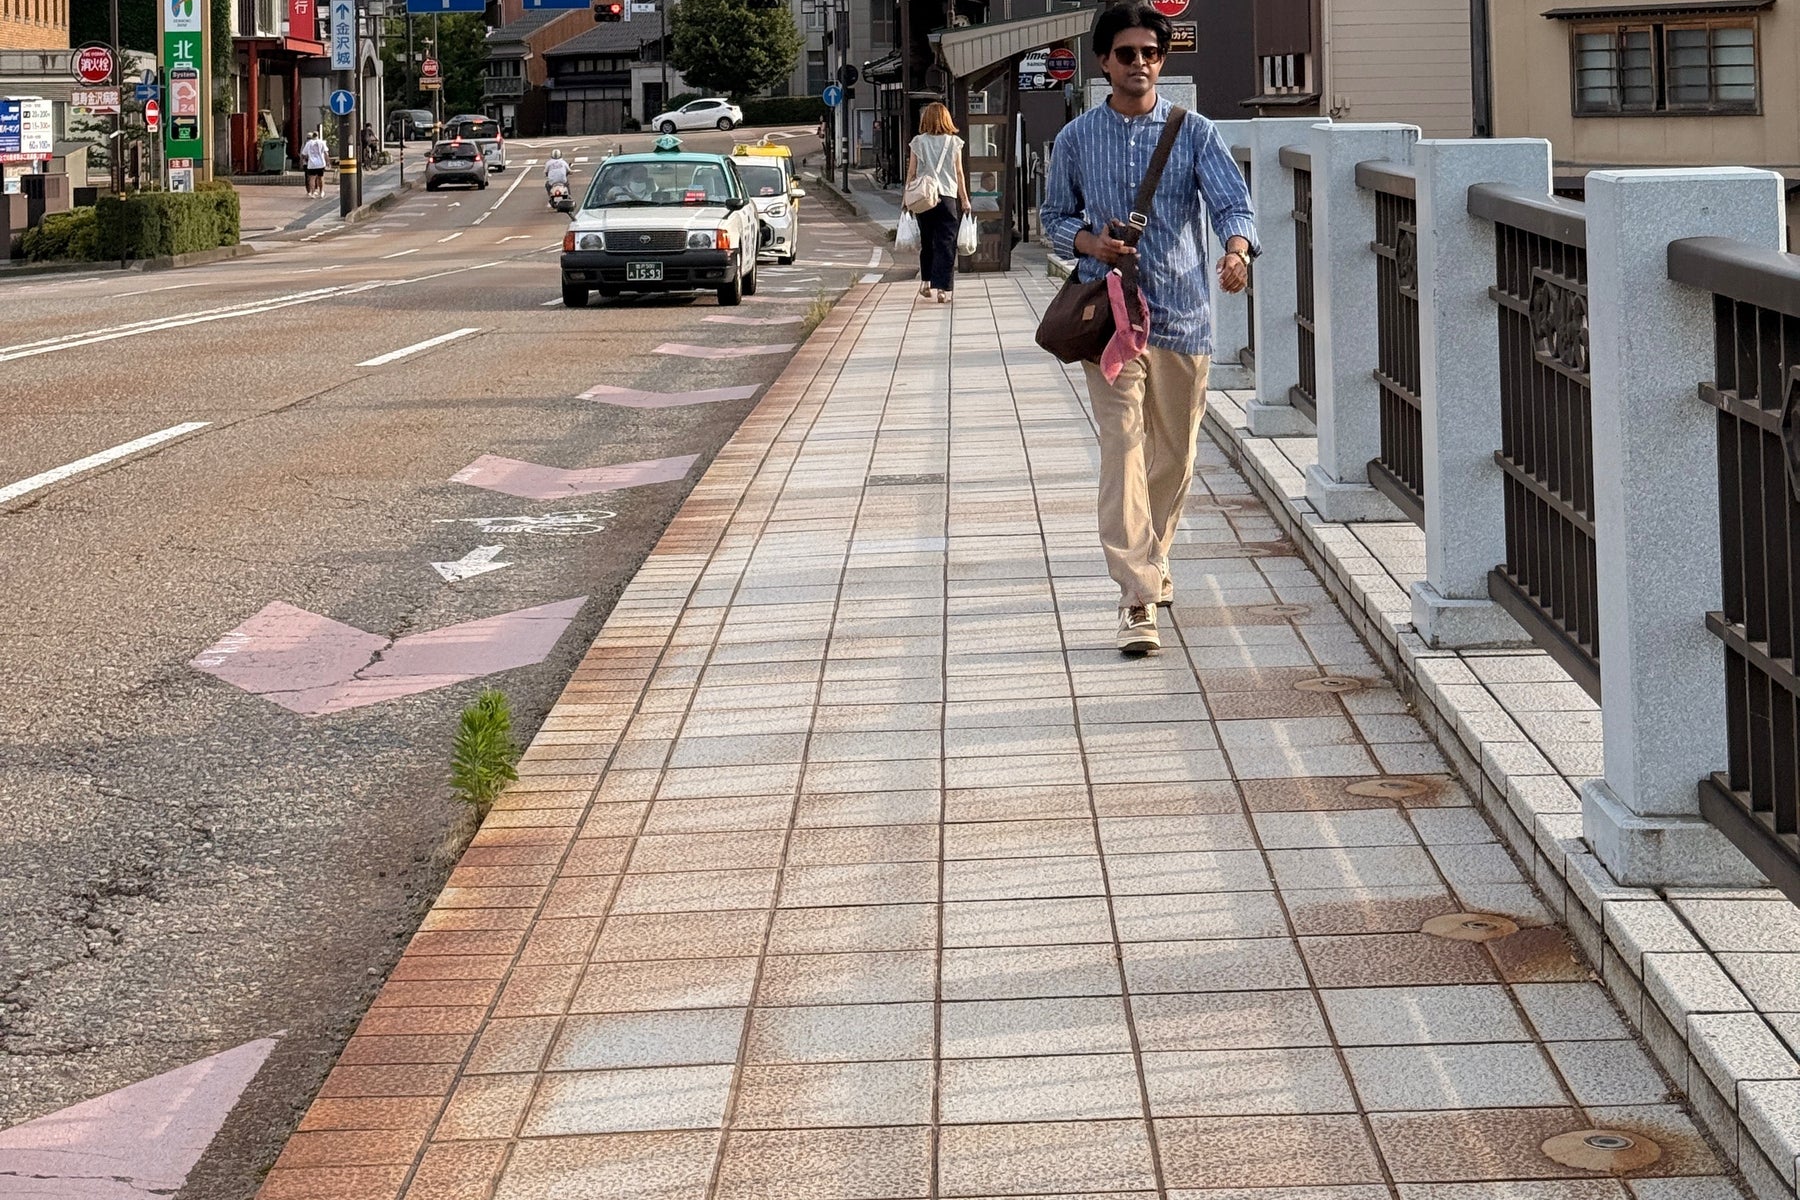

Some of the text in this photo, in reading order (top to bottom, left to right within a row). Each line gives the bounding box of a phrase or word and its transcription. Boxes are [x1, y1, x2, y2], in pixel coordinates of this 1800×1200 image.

[336, 22, 351, 65] 金沢城
[80, 57, 110, 72] 消火栓
[180, 104, 195, 113] 24
